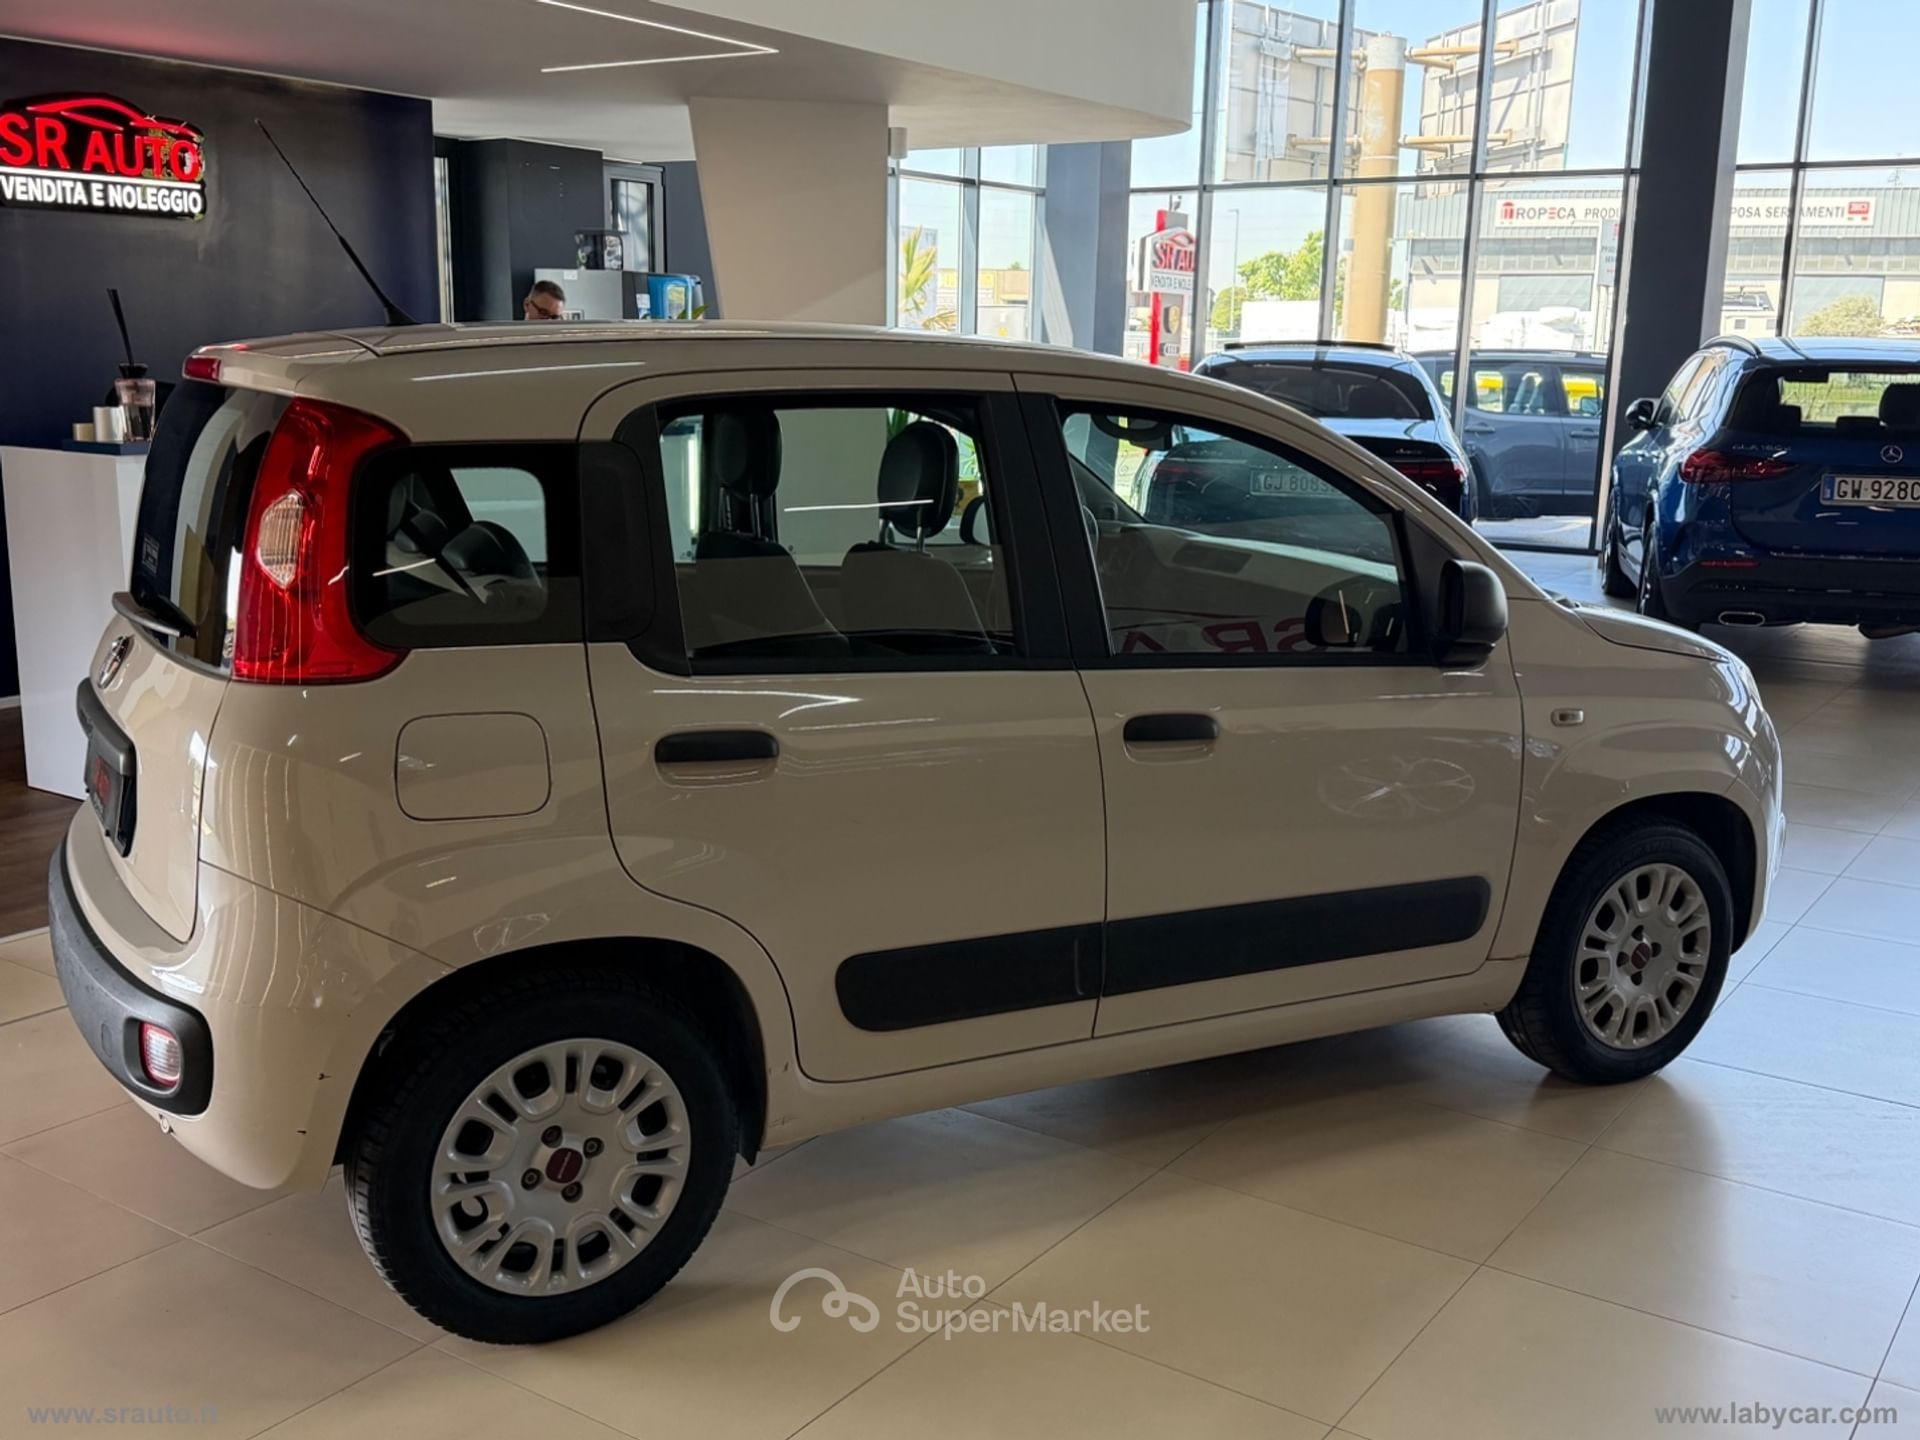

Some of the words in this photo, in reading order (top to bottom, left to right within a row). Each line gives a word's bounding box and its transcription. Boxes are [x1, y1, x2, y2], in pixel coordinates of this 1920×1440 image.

[0, 113, 70, 169] SR
[83, 131, 201, 181] AUTO
[0, 175, 88, 206] VENDITA
[91, 182, 105, 207] E
[108, 184, 202, 213] NOLEGGIO
[1837, 479, 1863, 499] GW
